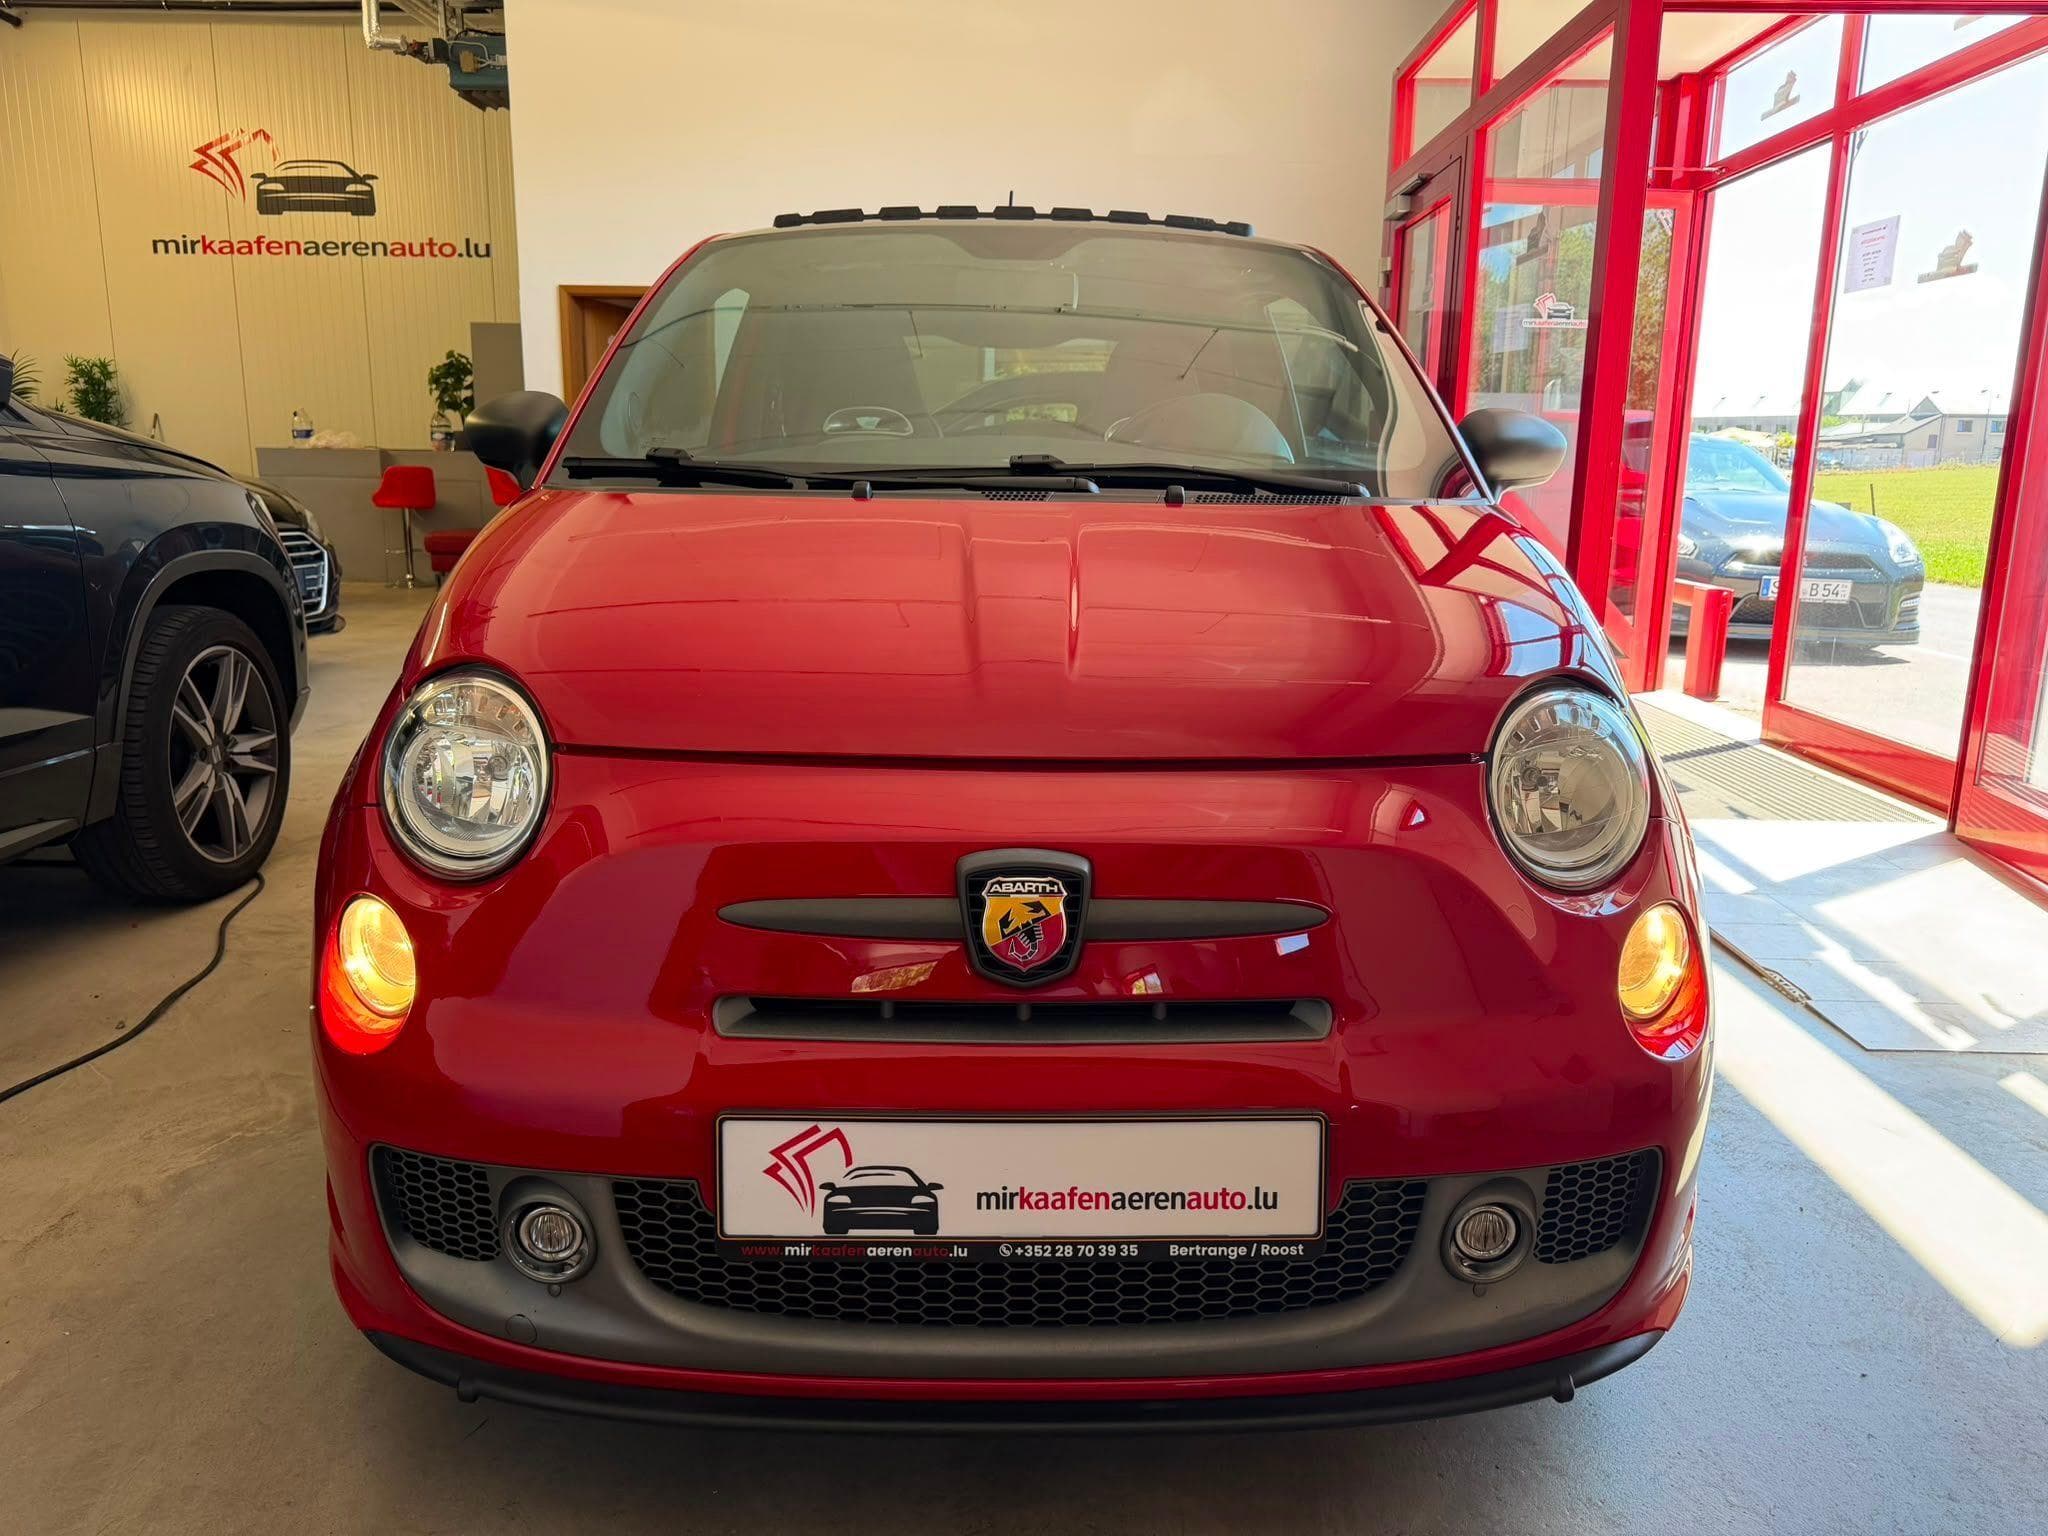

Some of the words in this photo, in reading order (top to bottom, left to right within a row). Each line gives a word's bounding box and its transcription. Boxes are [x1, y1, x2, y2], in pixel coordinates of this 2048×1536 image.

[152, 234, 491, 258] mirkaafenaerenauto.lu
[1809, 583, 1819, 597] B
[1821, 583, 1841, 598] 54
[990, 882, 1058, 893] ABARTH
[976, 1185, 1278, 1211] mirkaafenaerenauto.lu
[741, 1243, 968, 1257] www.mirkaafenaerenauto.lu
[1014, 1244, 1052, 1257] +352
[1055, 1244, 1073, 1257] 28
[1076, 1244, 1095, 1257] 70
[1098, 1244, 1117, 1257] 39
[1119, 1244, 1138, 1257] 35
[1169, 1244, 1247, 1259] Bertrange
[1250, 1243, 1258, 1258] /
[1261, 1243, 1304, 1256] Roost
